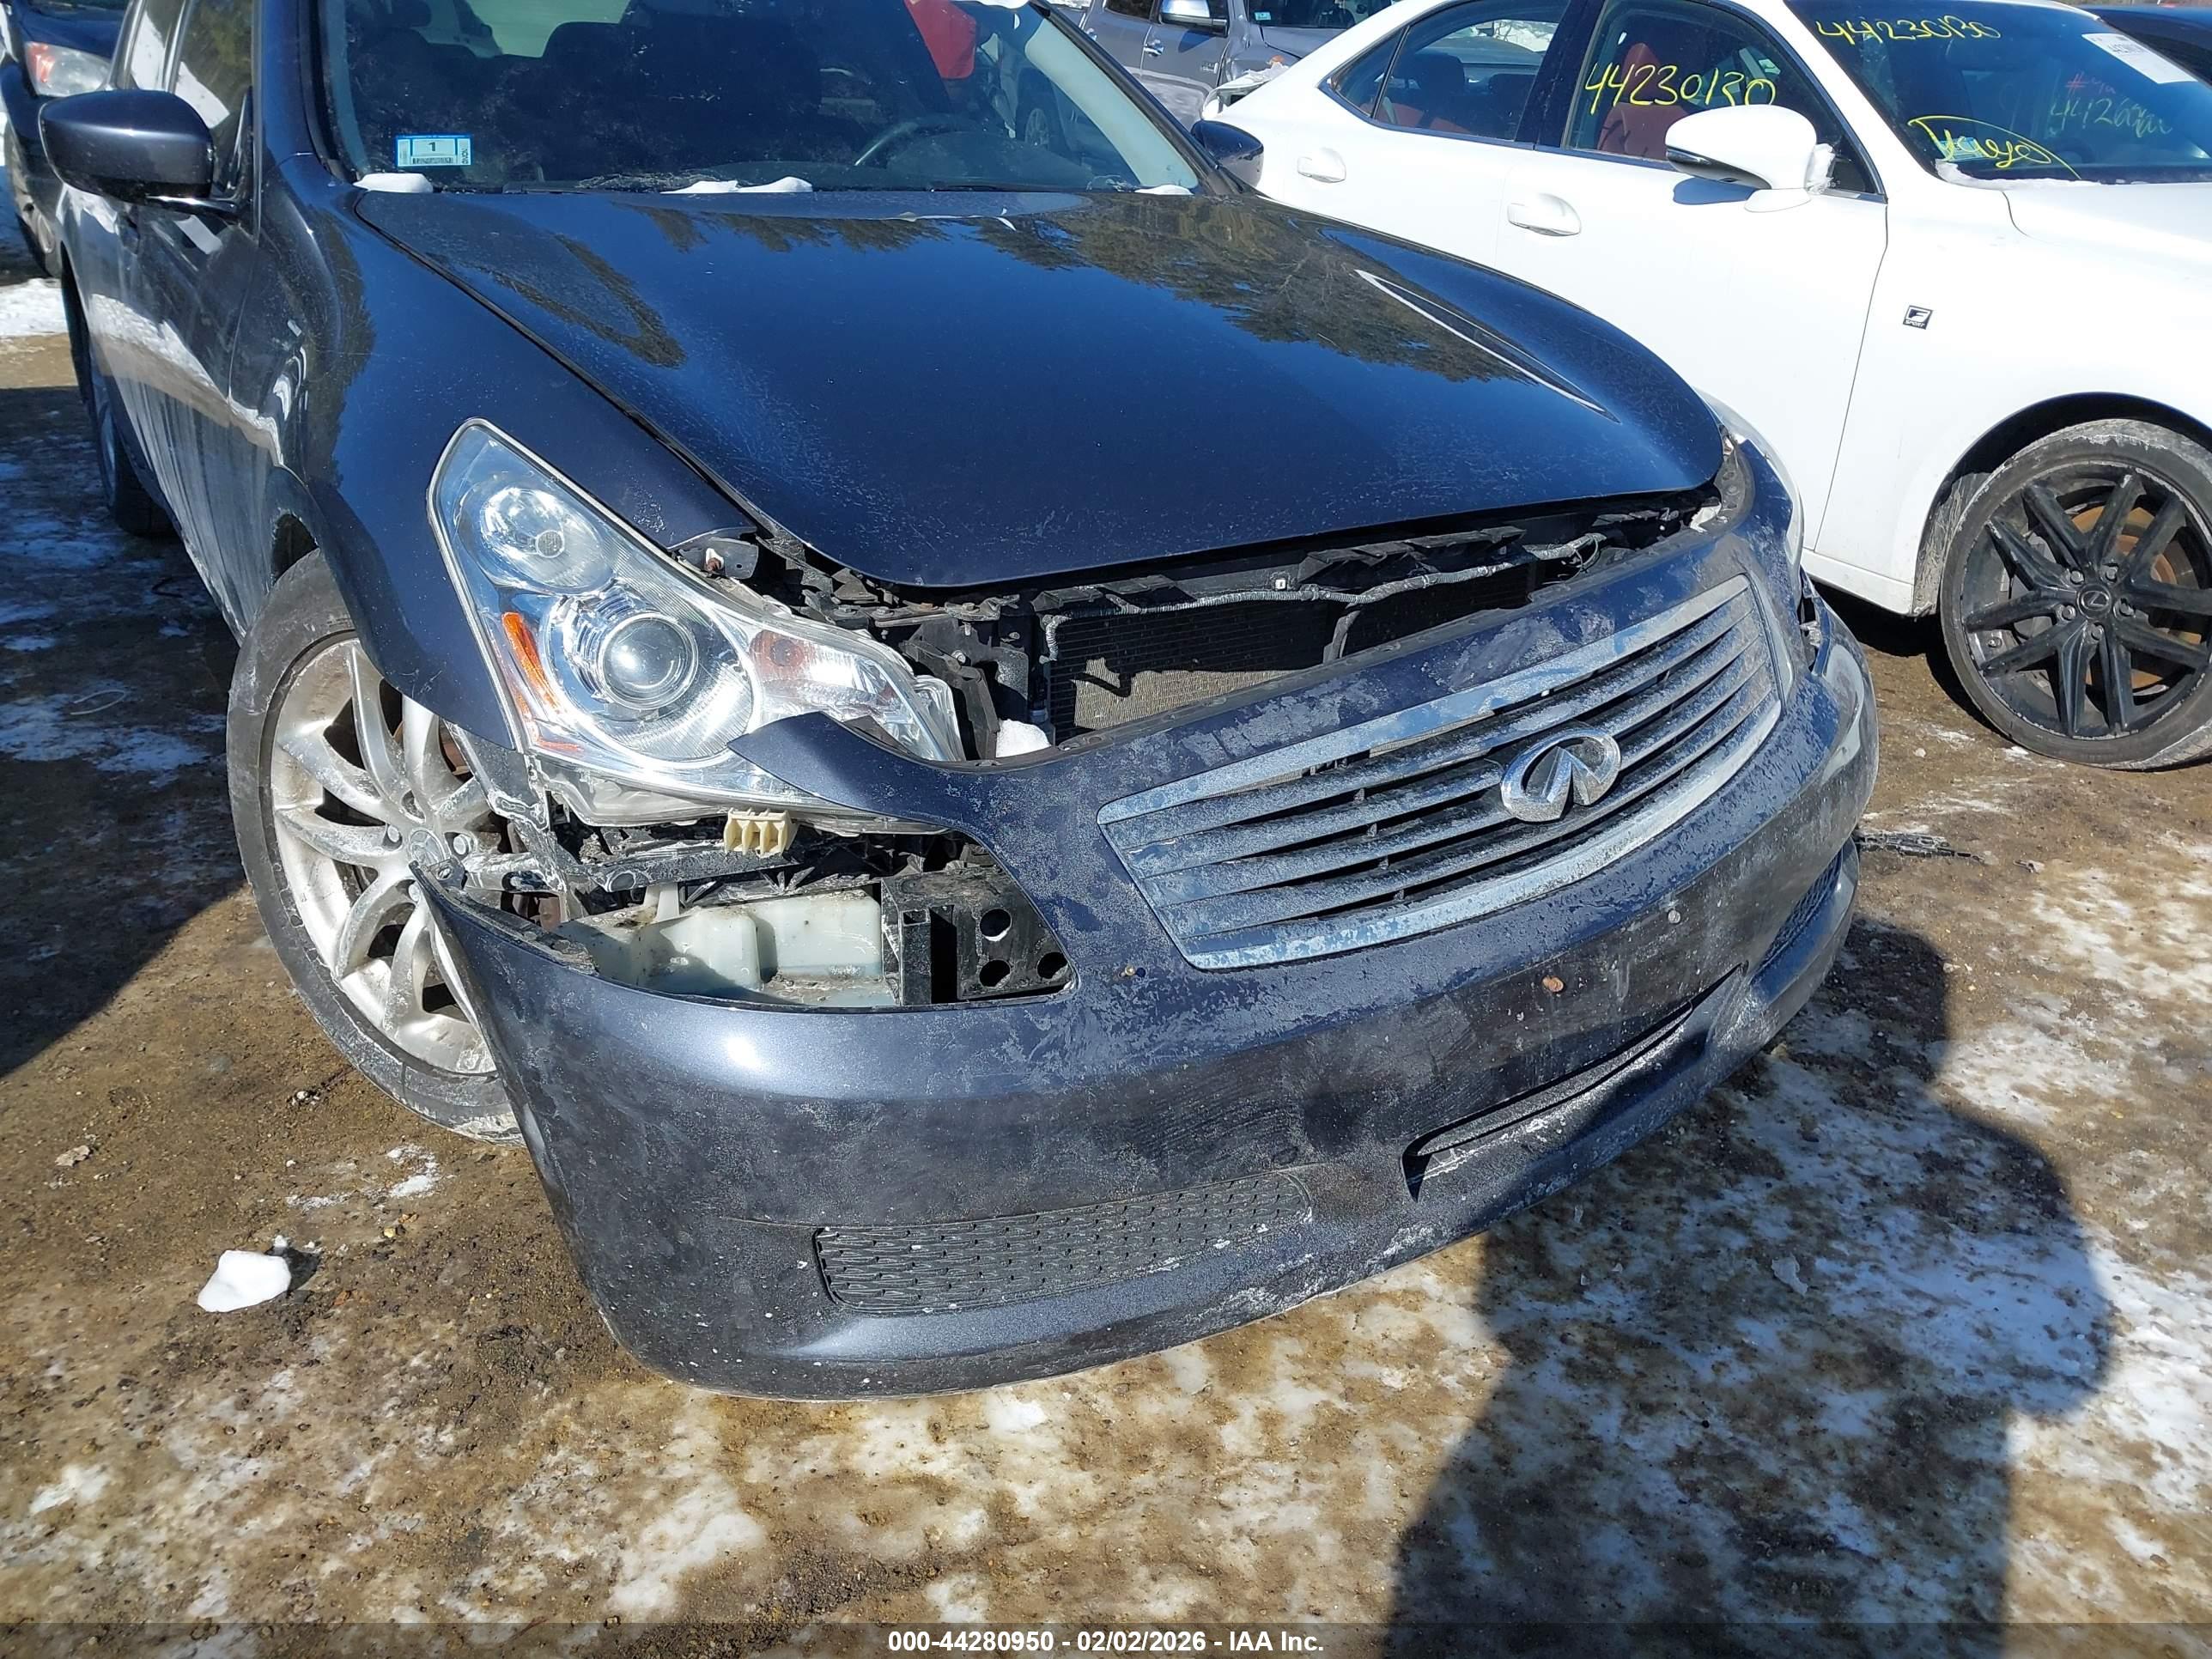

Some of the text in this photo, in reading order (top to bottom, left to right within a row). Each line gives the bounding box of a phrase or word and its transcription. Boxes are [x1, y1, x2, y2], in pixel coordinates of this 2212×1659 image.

[1816, 15, 2002, 45] 44230130
[1584, 63, 1777, 115] 44230130
[428, 142, 436, 152] 1
